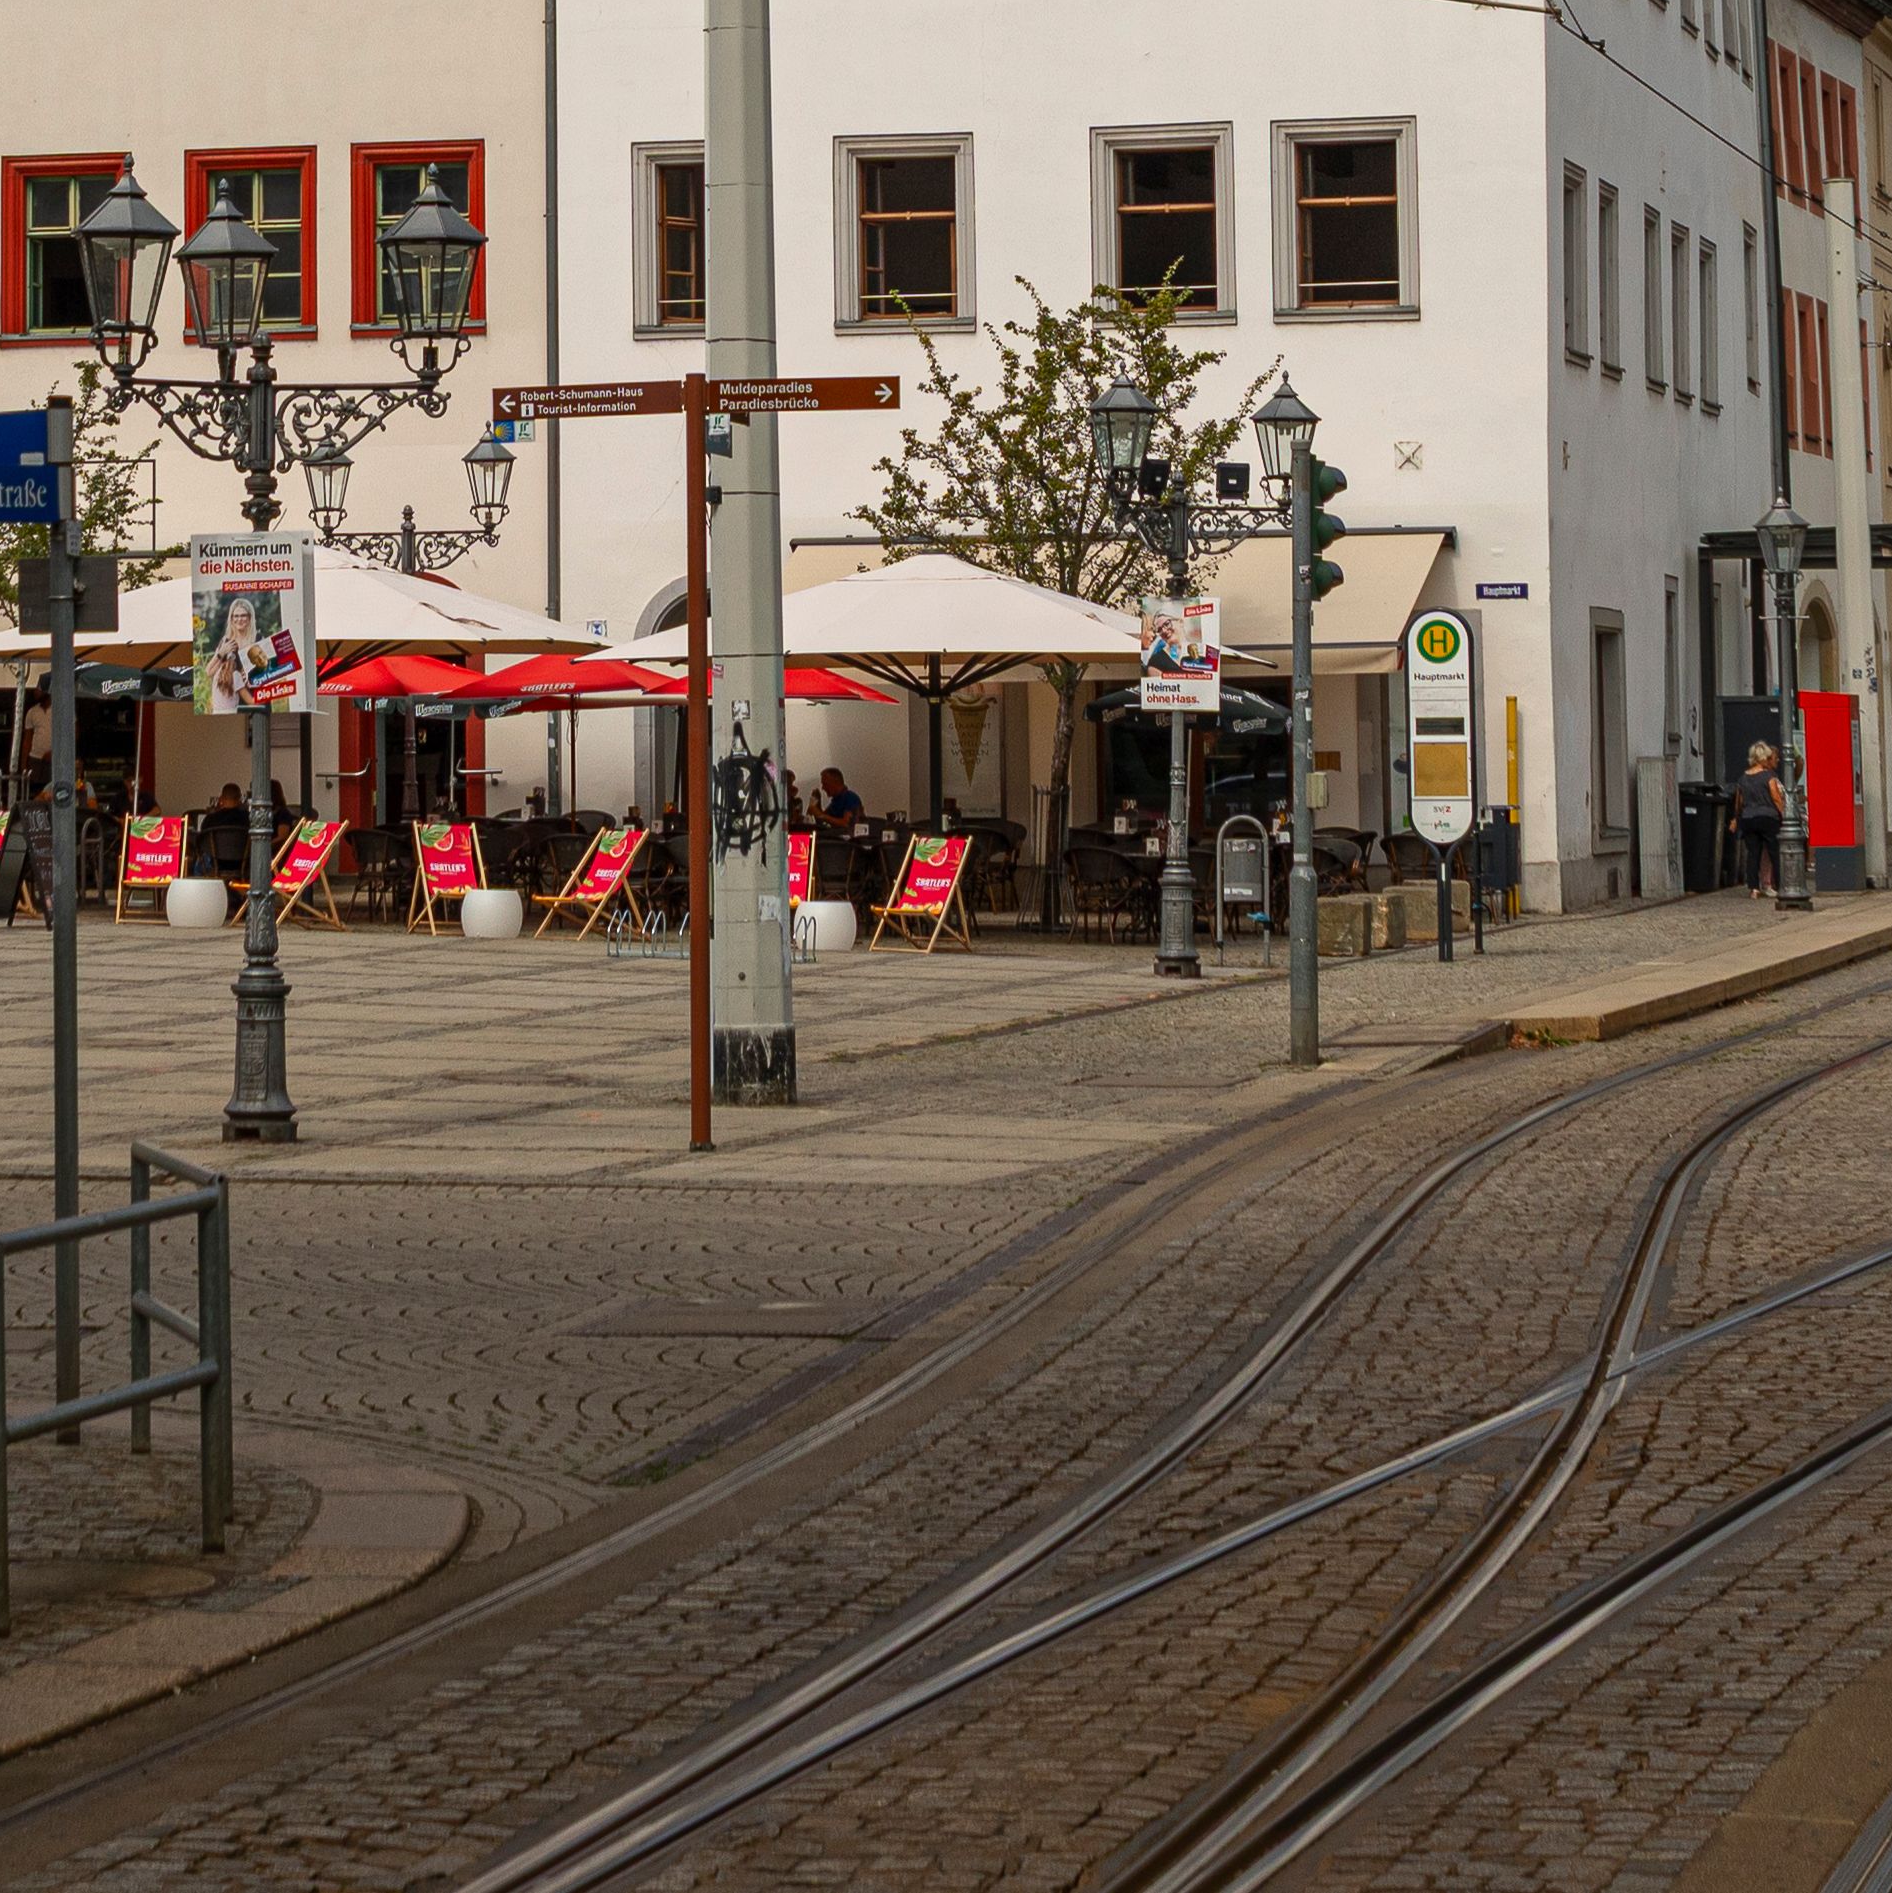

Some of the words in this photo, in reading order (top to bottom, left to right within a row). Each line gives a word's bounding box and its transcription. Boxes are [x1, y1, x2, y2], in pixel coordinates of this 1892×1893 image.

[519, 387, 644, 402] Robert-Schumann-Haus
[719, 381, 813, 399] Muldeparadies
[537, 401, 637, 415] Tourist-Information
[719, 396, 819, 412] Paradiesbrücke
[199, 543, 269, 558] Kümmern
[270, 543, 292, 555] um
[199, 560, 222, 575] die
[224, 558, 294, 574] Nächsten.
[1483, 586, 1521, 596] Hauptmarkt
[1429, 629, 1448, 653] H
[1413, 672, 1465, 682] Hauptmarkt
[1146, 682, 1181, 693] Heimat
[1147, 694, 1171, 704] ohne
[1172, 694, 1200, 705] Hass.
